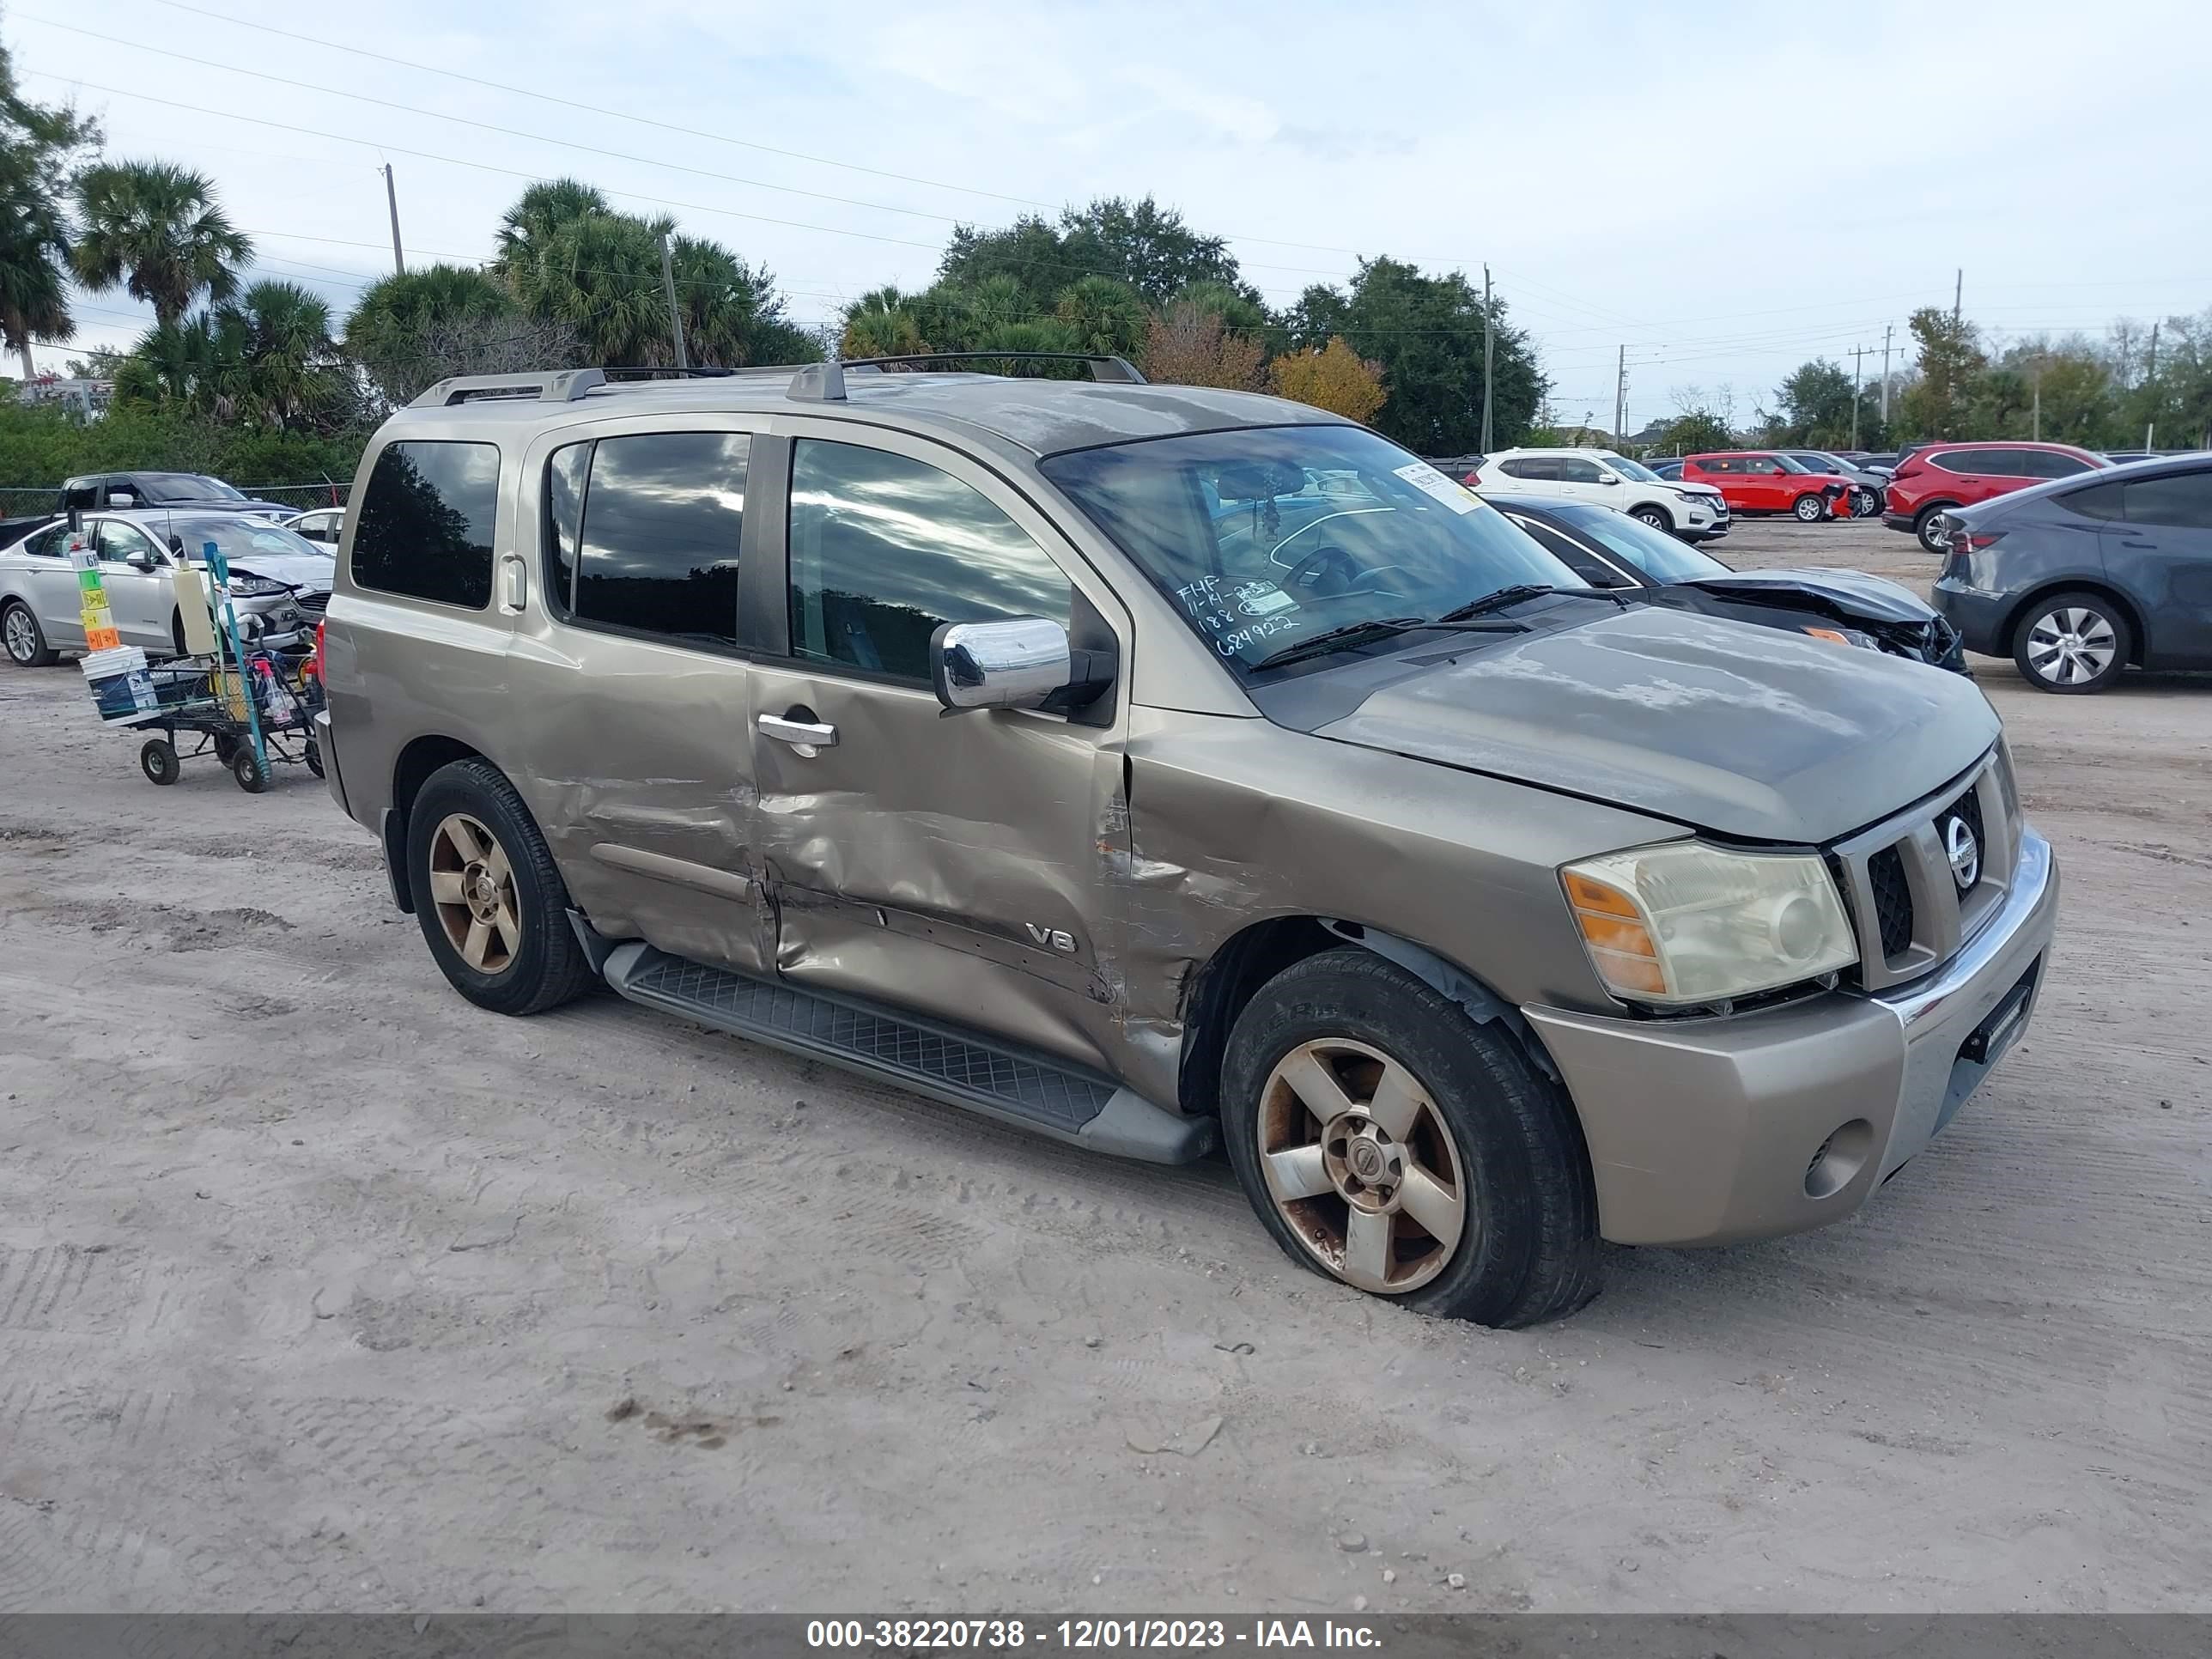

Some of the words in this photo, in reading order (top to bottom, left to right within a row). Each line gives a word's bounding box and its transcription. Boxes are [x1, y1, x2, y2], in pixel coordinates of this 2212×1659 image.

[1198, 609, 1235, 633] 188
[1217, 616, 1301, 656] 684922
[1025, 922, 1078, 952] V8
